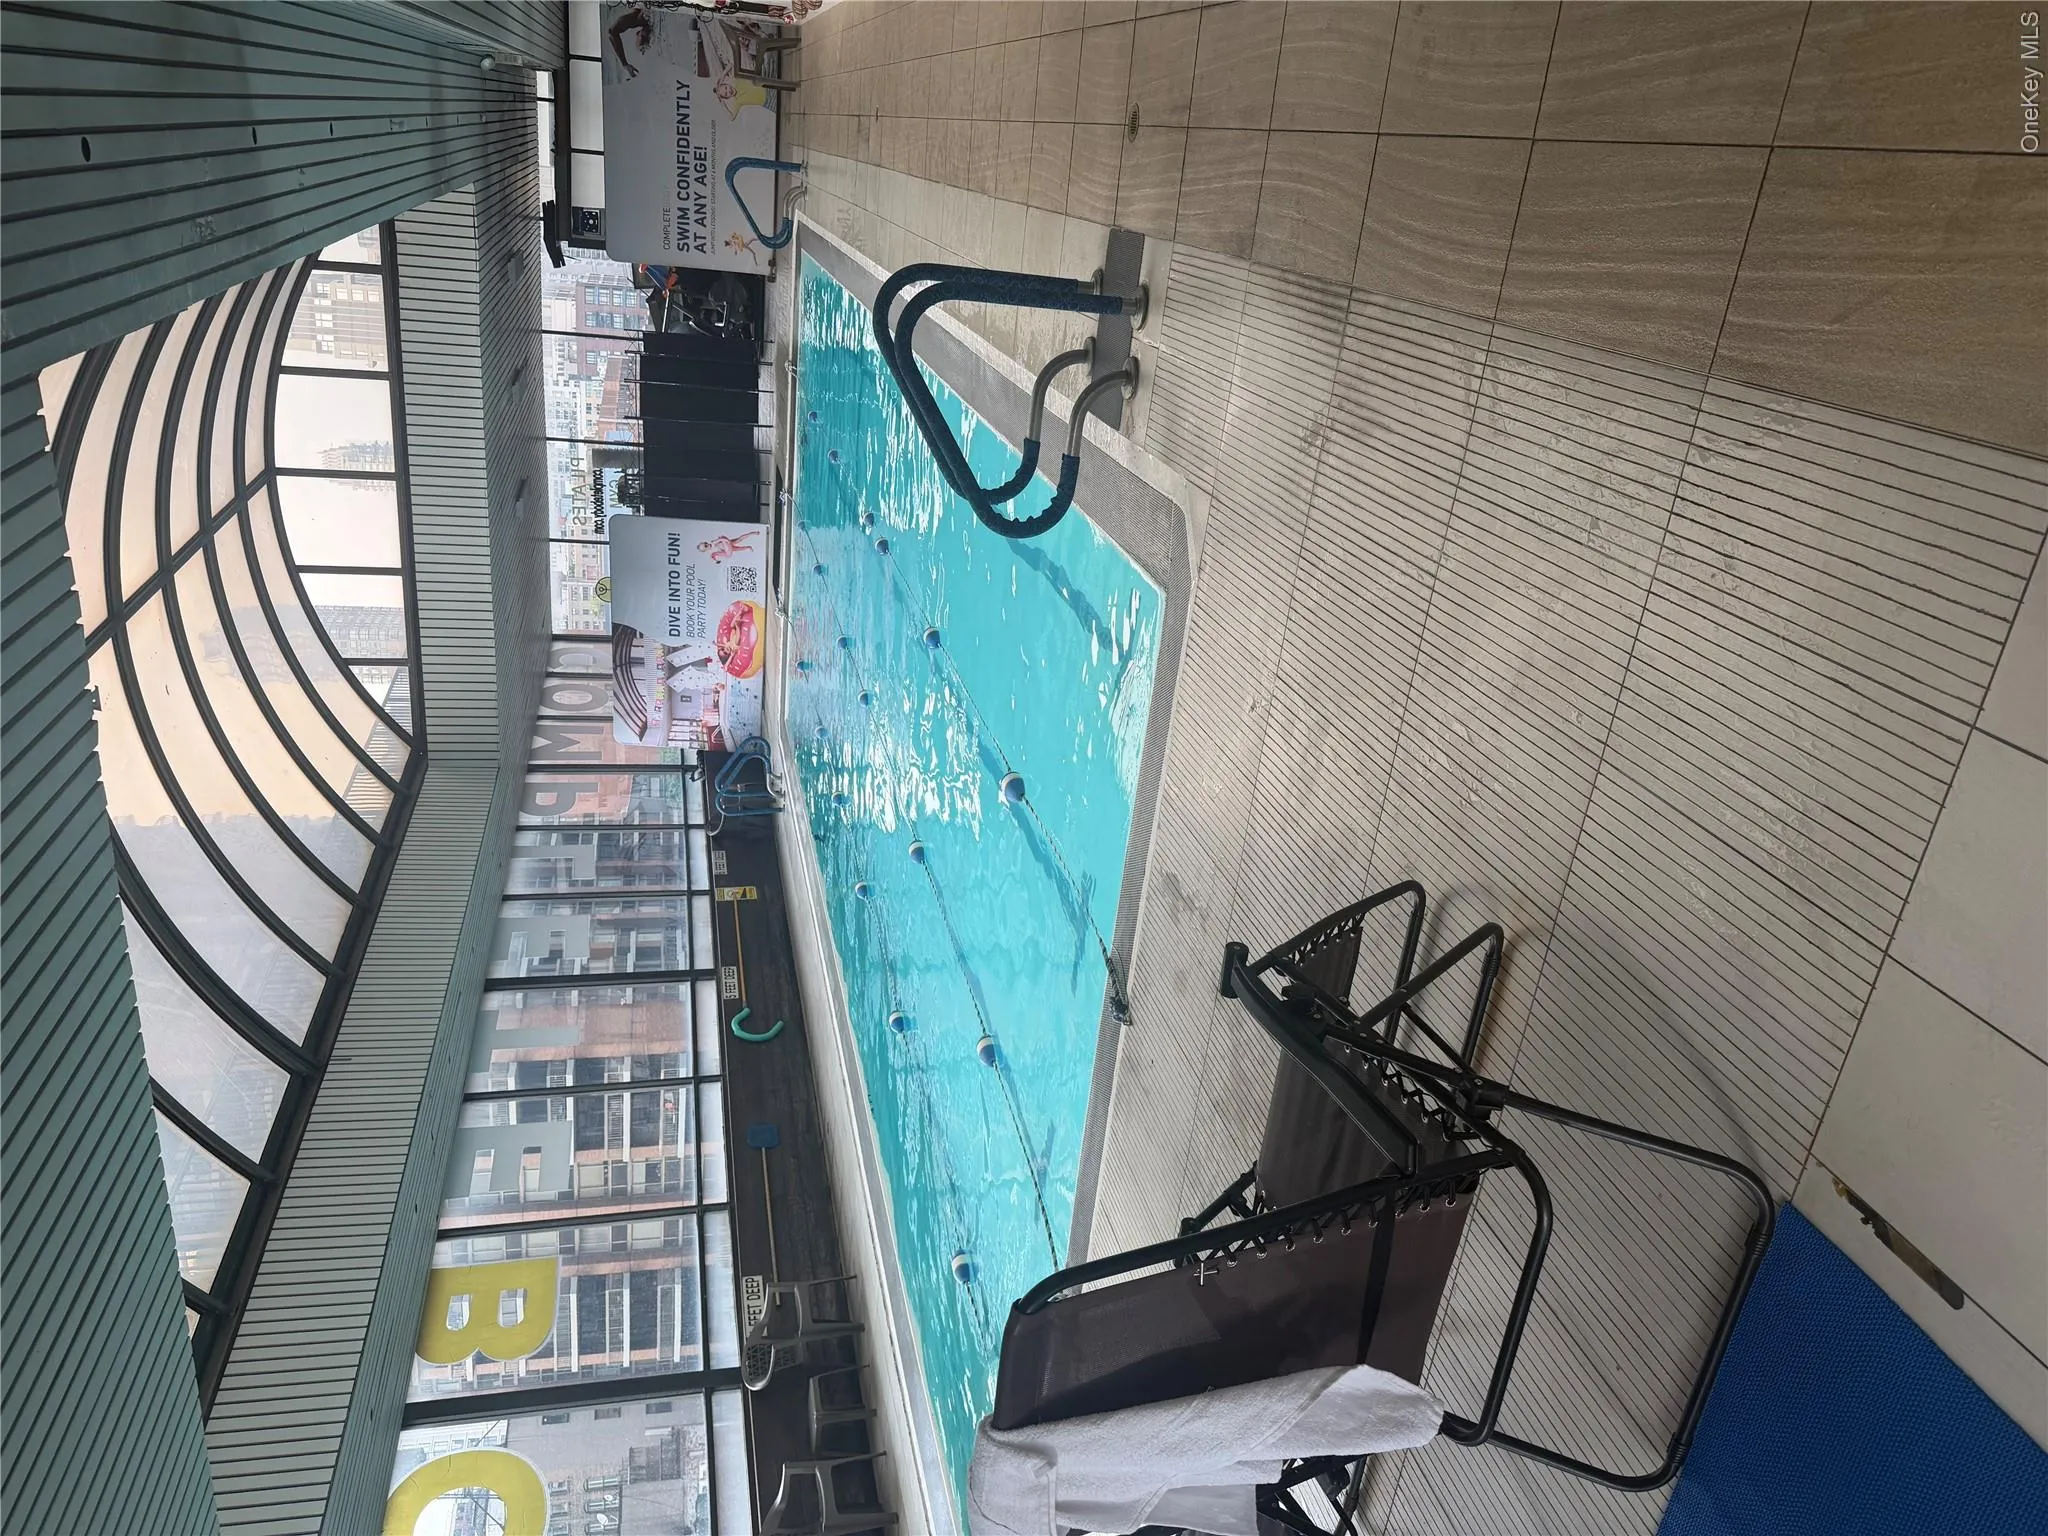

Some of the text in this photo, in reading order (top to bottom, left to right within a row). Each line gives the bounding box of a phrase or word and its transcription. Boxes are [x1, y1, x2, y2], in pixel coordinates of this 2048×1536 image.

[675, 79, 691, 253] SWIM CONFIDENTLY
[693, 146, 707, 255] AT ANY AGE!
[667, 532, 681, 638] DIVE INTO FUN!
[686, 563, 696, 638] BOOK YOUR POOL
[697, 579, 707, 639] PARTY TODAY!
[722, 967, 735, 980] DEEP
[723, 981, 736, 994] FEET
[745, 1277, 761, 1301] DEEP
